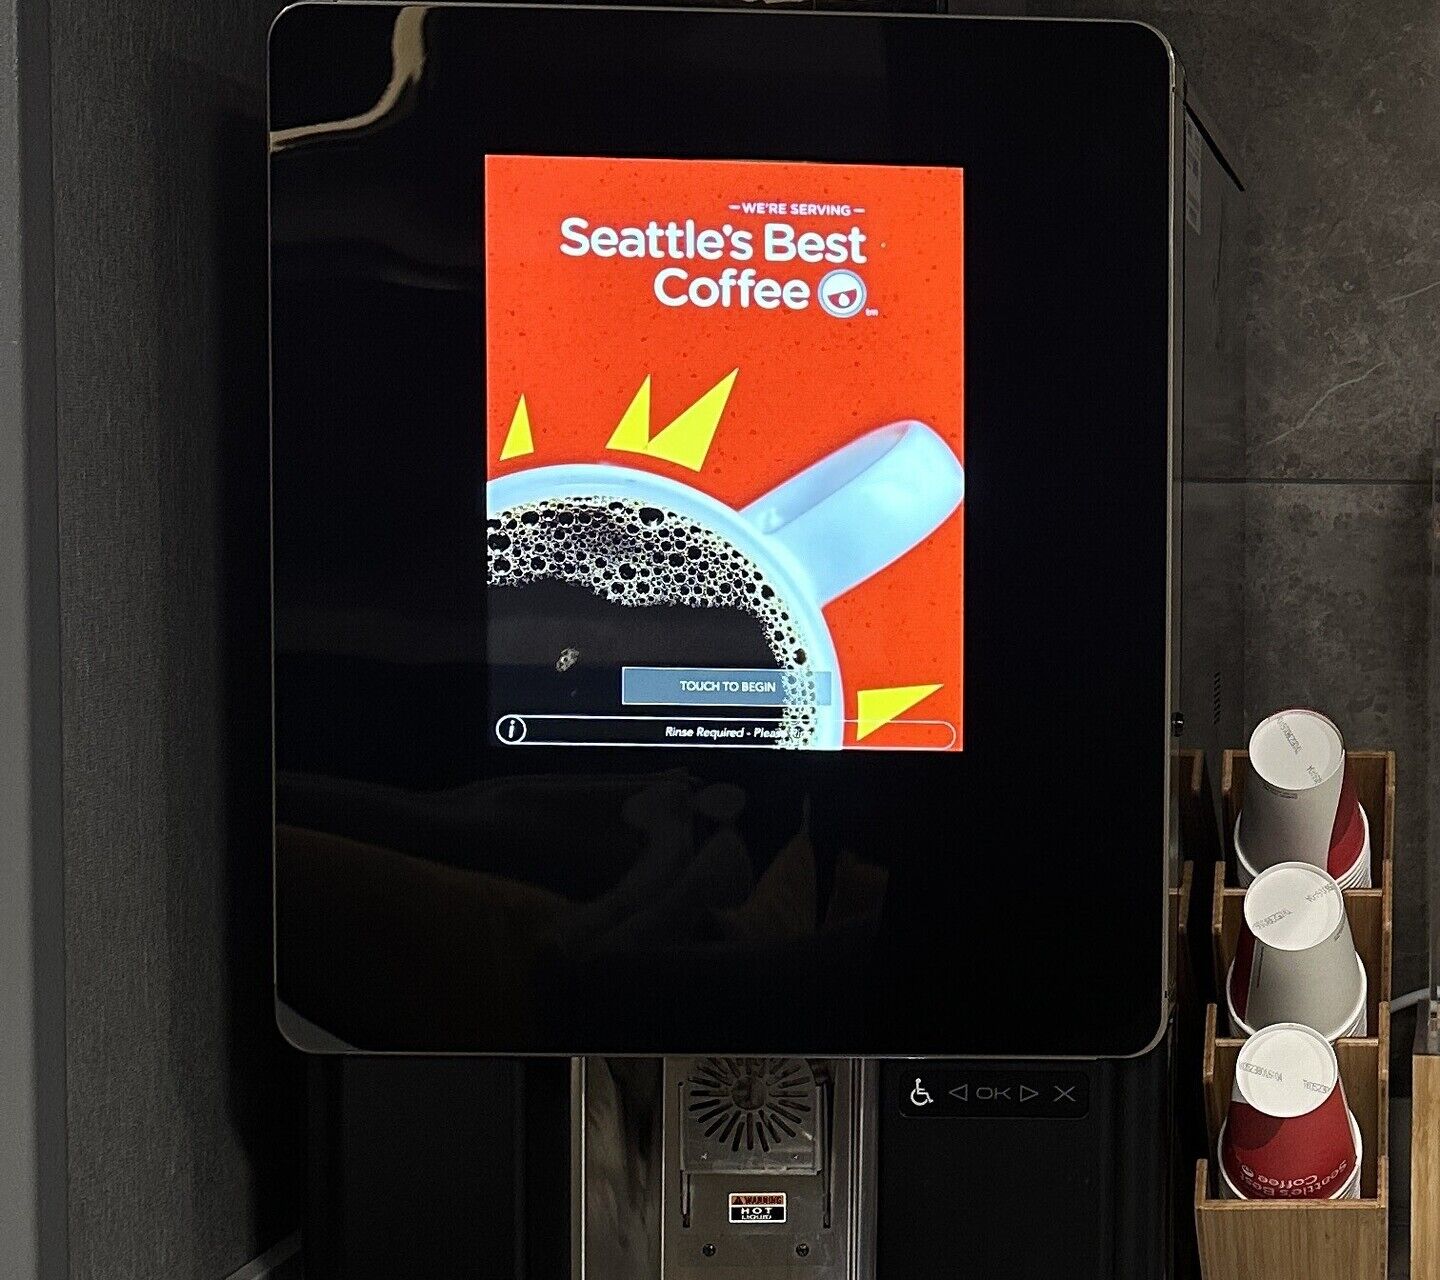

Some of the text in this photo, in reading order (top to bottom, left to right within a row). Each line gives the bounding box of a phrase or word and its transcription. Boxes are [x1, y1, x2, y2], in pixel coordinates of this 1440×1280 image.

[741, 202, 852, 217] WE'RE SERVING
[560, 217, 868, 264] Seattle's Best
[653, 267, 811, 310] Coffee
[679, 680, 777, 693] TOUCH TO BEGIN
[665, 726, 694, 738] Rinse
[696, 726, 745, 741] Required
[753, 727, 788, 739] Pleas
[975, 1086, 1012, 1100] OK
[1257, 1174, 1318, 1190] Coffee
[740, 1207, 773, 1215] HOT
